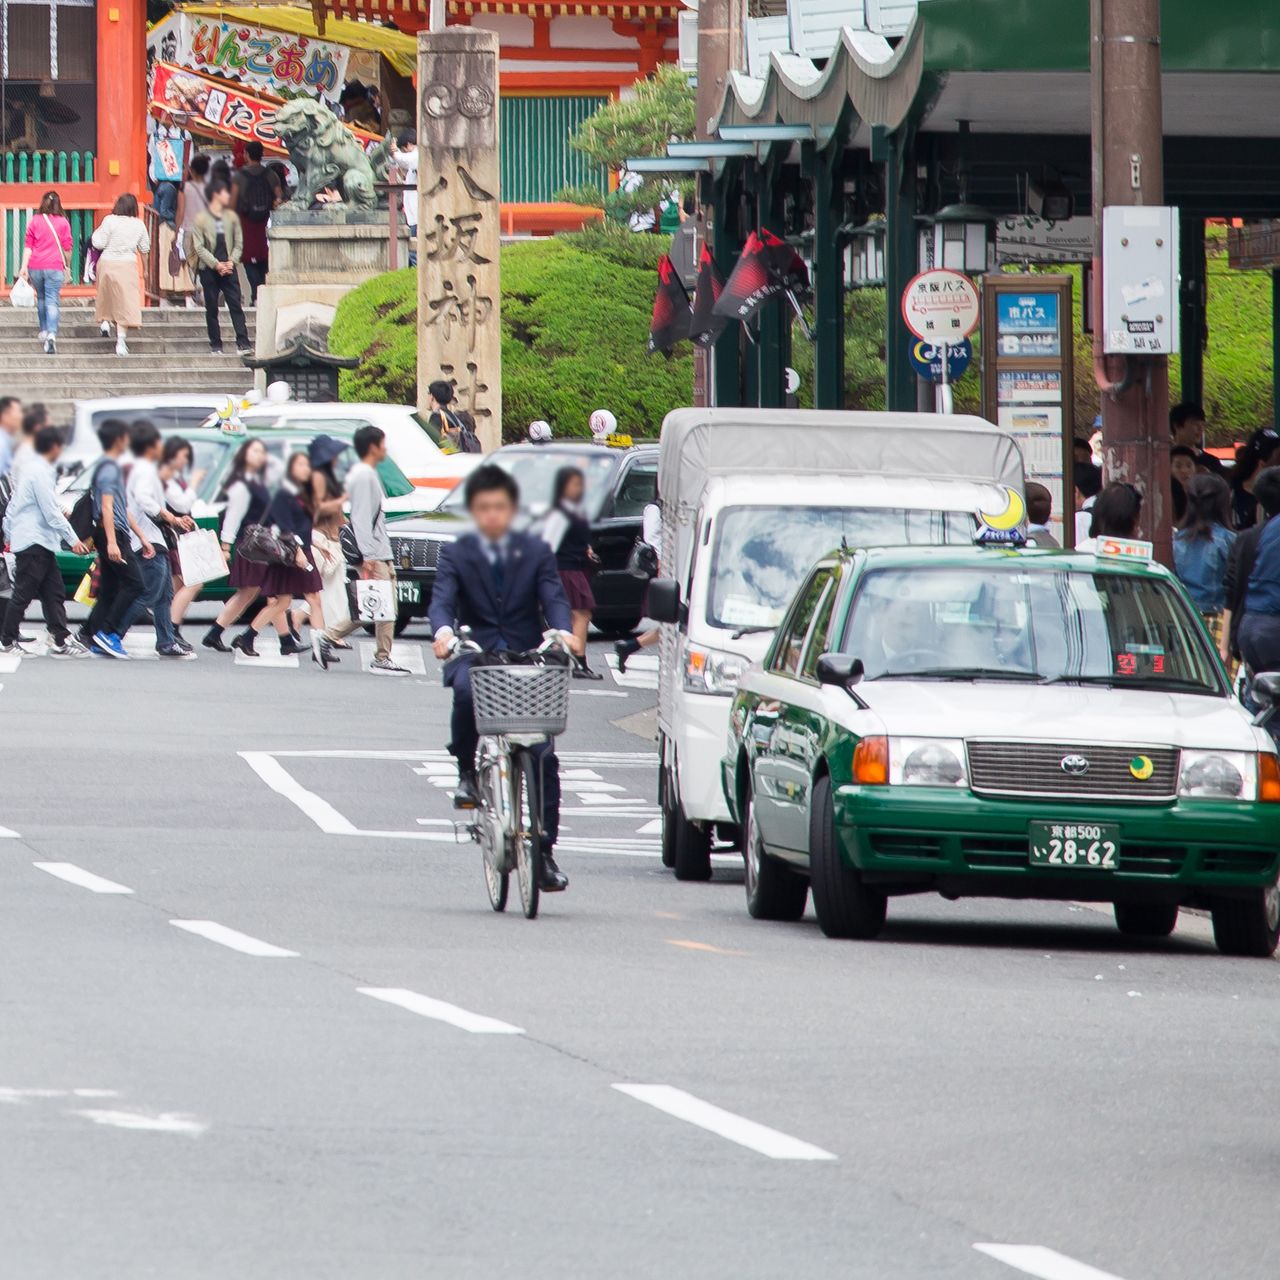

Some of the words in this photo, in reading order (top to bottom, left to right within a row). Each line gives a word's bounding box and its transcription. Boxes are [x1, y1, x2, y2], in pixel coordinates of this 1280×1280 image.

[424, 165, 495, 420] 八坂神社
[1003, 335, 1020, 354] B
[1050, 824, 1101, 840] 京都500
[1033, 845, 1048, 858] い
[1048, 839, 1116, 866] 28-62
